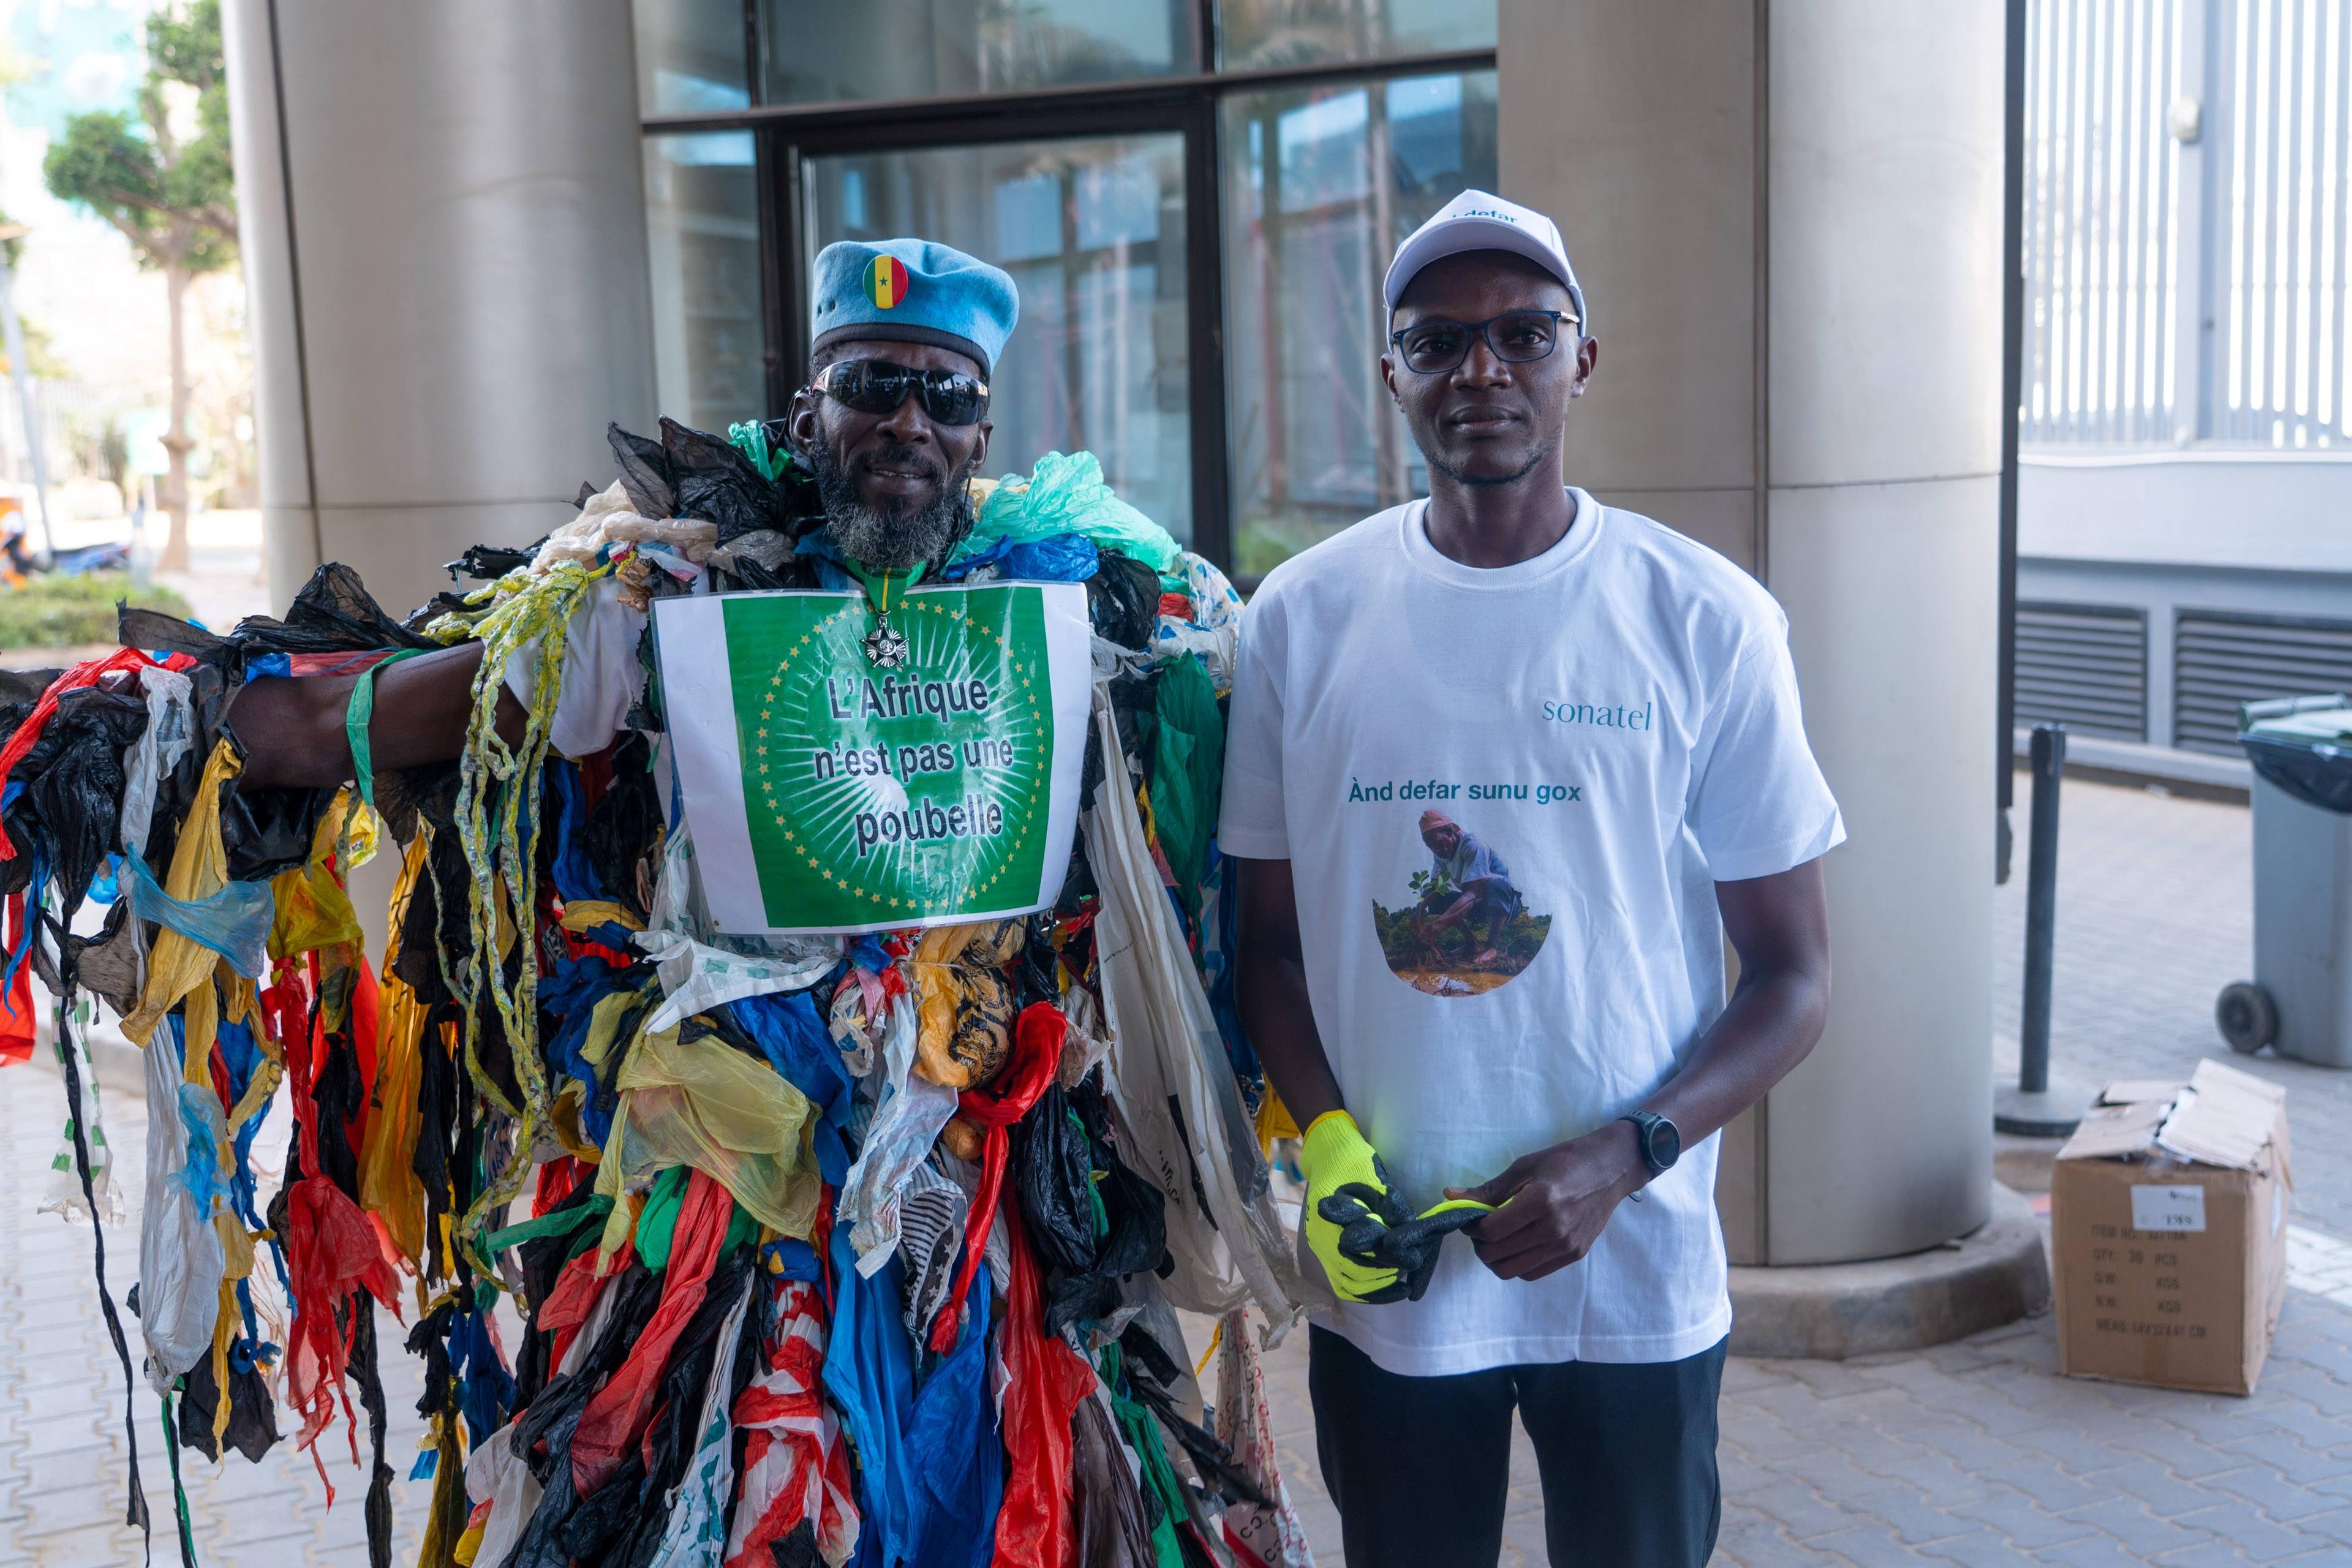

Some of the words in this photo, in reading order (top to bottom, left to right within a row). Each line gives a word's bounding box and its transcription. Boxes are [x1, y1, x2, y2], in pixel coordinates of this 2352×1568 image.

[1542, 700, 1652, 731] sonatel
[899, 743, 954, 782] pas
[963, 739, 1013, 767] une
[1348, 777, 1393, 802] Ànd
[1400, 780, 1460, 800] defar
[1468, 784, 1528, 800] sunu
[1536, 785, 1581, 805] gox
[855, 794, 1002, 857] poubelle
